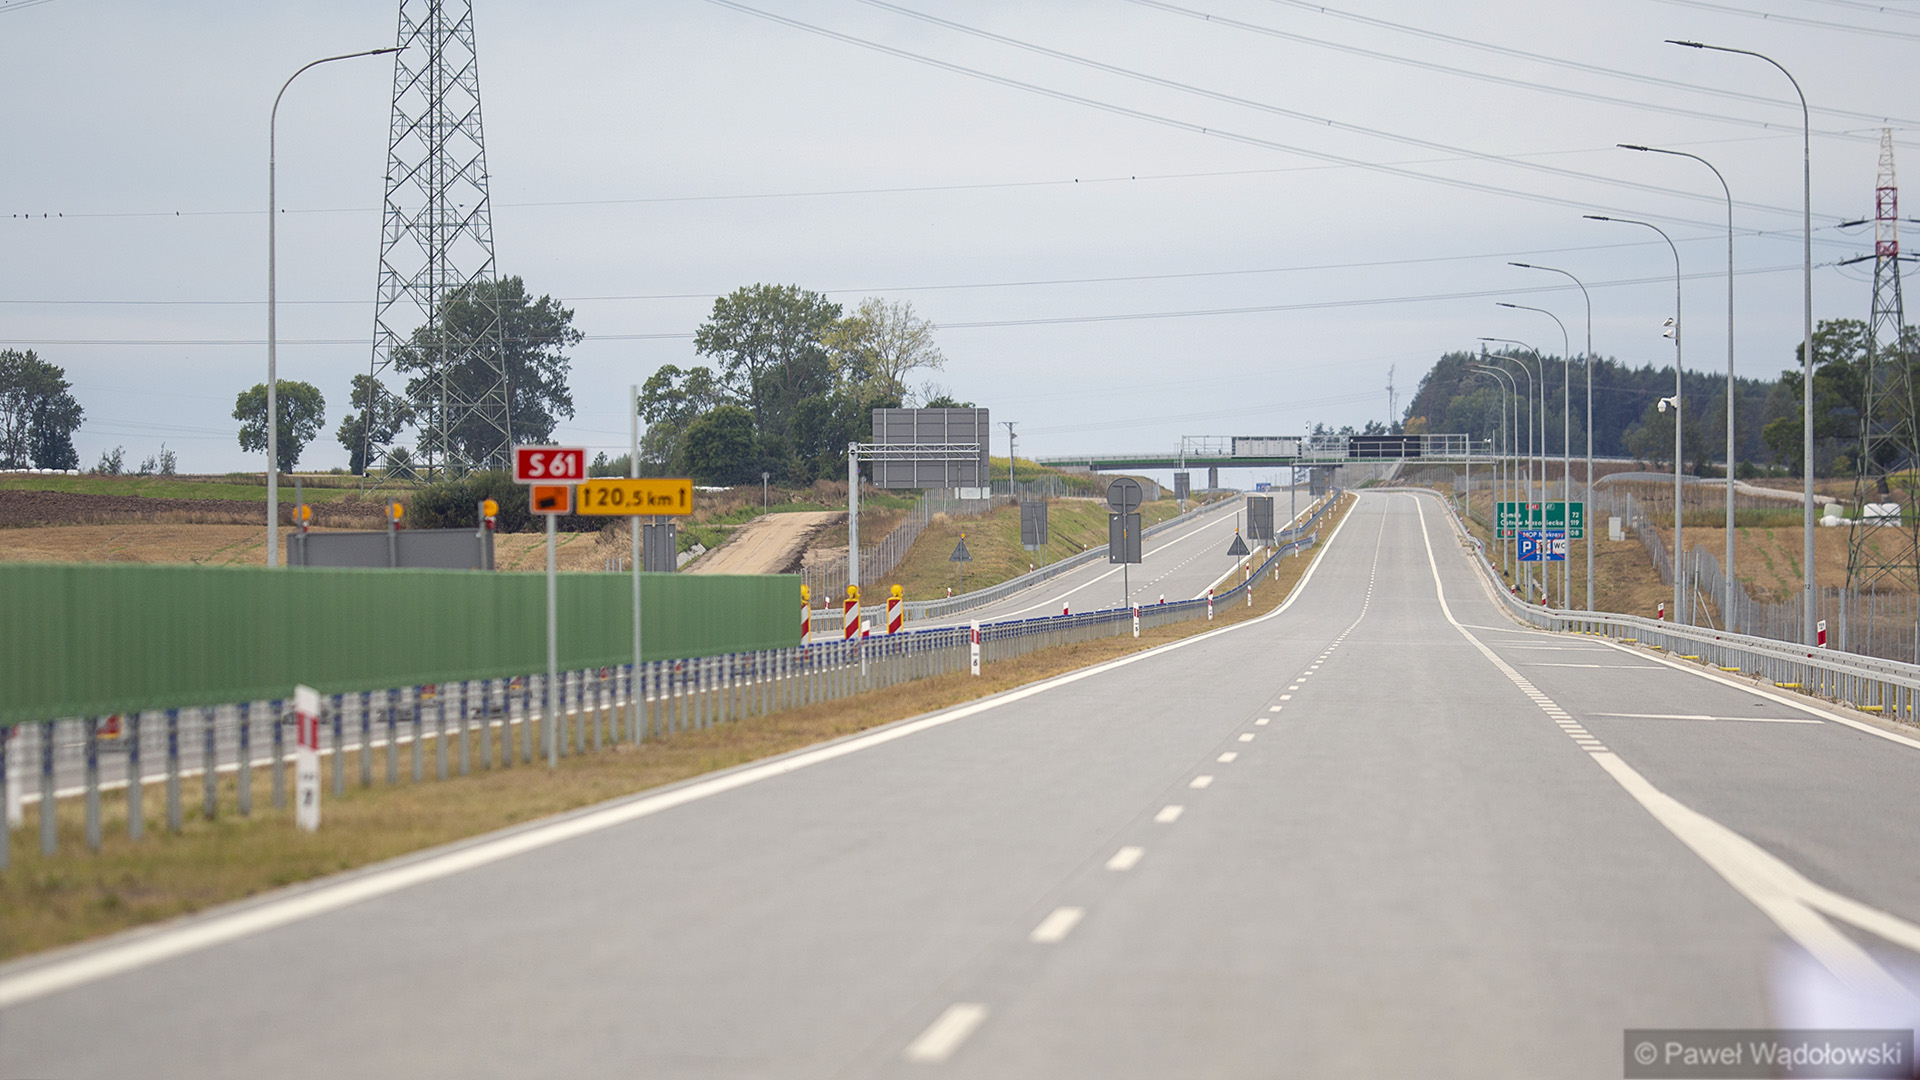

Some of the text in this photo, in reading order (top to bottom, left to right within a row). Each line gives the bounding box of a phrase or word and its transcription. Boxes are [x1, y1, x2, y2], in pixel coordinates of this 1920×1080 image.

[528, 453, 576, 477] S 61
[597, 488, 671, 507] 20,5 km
[1523, 541, 1531, 553] P
